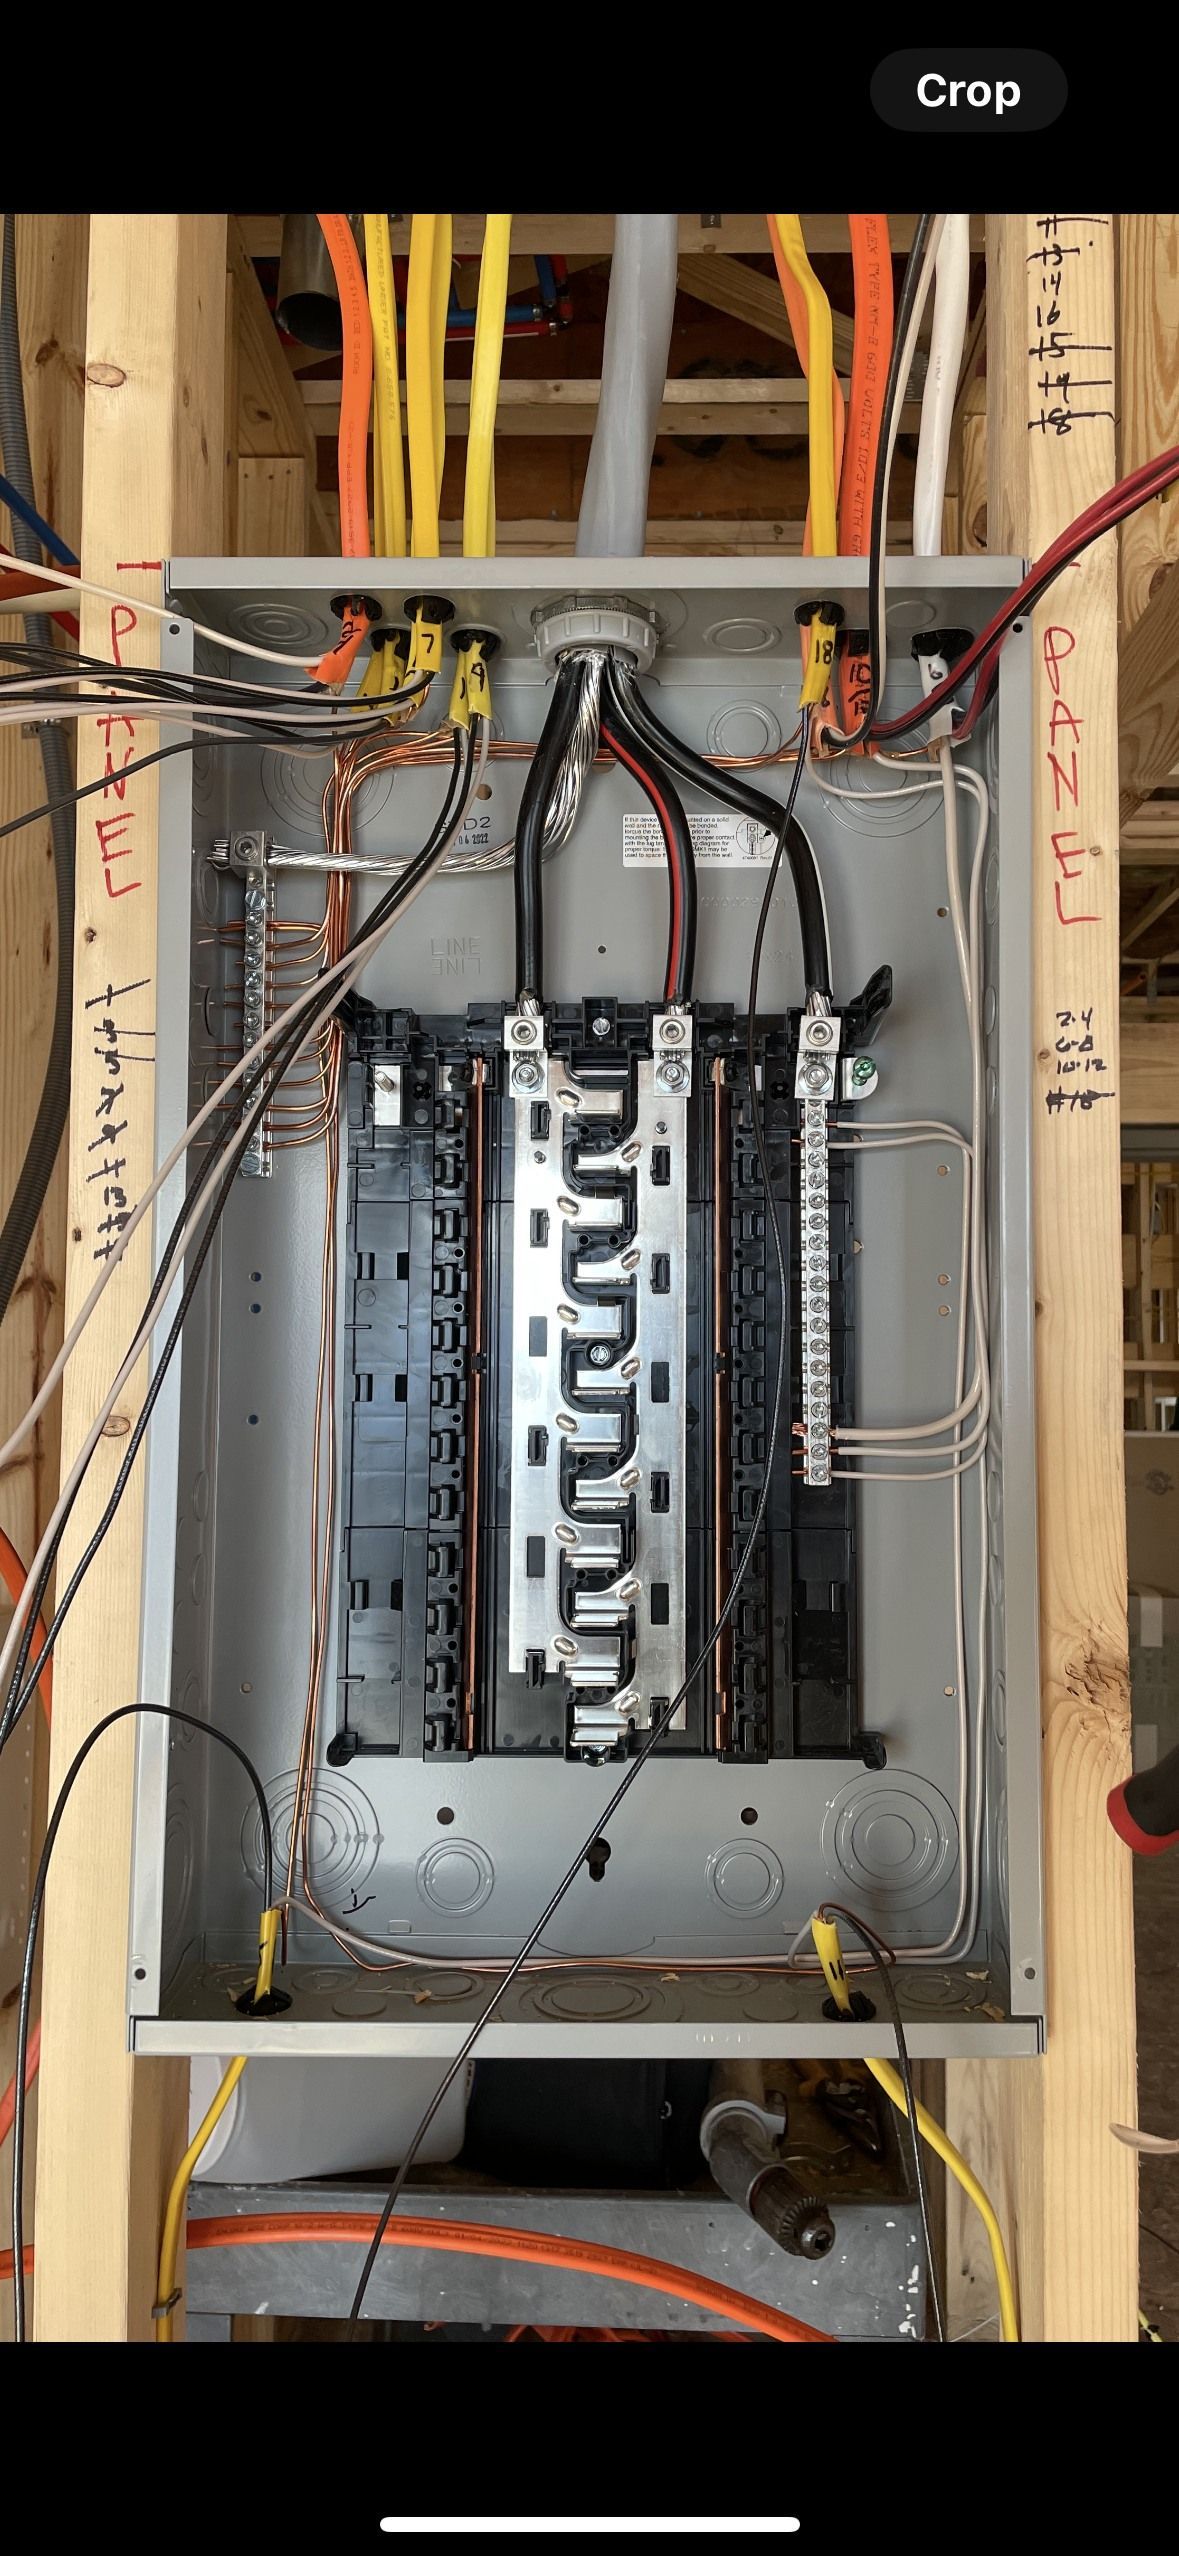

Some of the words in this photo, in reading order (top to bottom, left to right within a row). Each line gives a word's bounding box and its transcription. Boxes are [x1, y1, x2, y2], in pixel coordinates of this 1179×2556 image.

[868, 262, 881, 300] TYPE
[1042, 271, 1062, 296] 14
[867, 305, 880, 346] NM-B
[1036, 300, 1061, 328] 16
[860, 389, 875, 441] VOLTS
[856, 446, 869, 482] 10/3
[421, 633, 435, 654] 7
[815, 639, 834, 665] 18
[1043, 626, 1102, 925] PANEL
[430, 935, 482, 957] LINE
